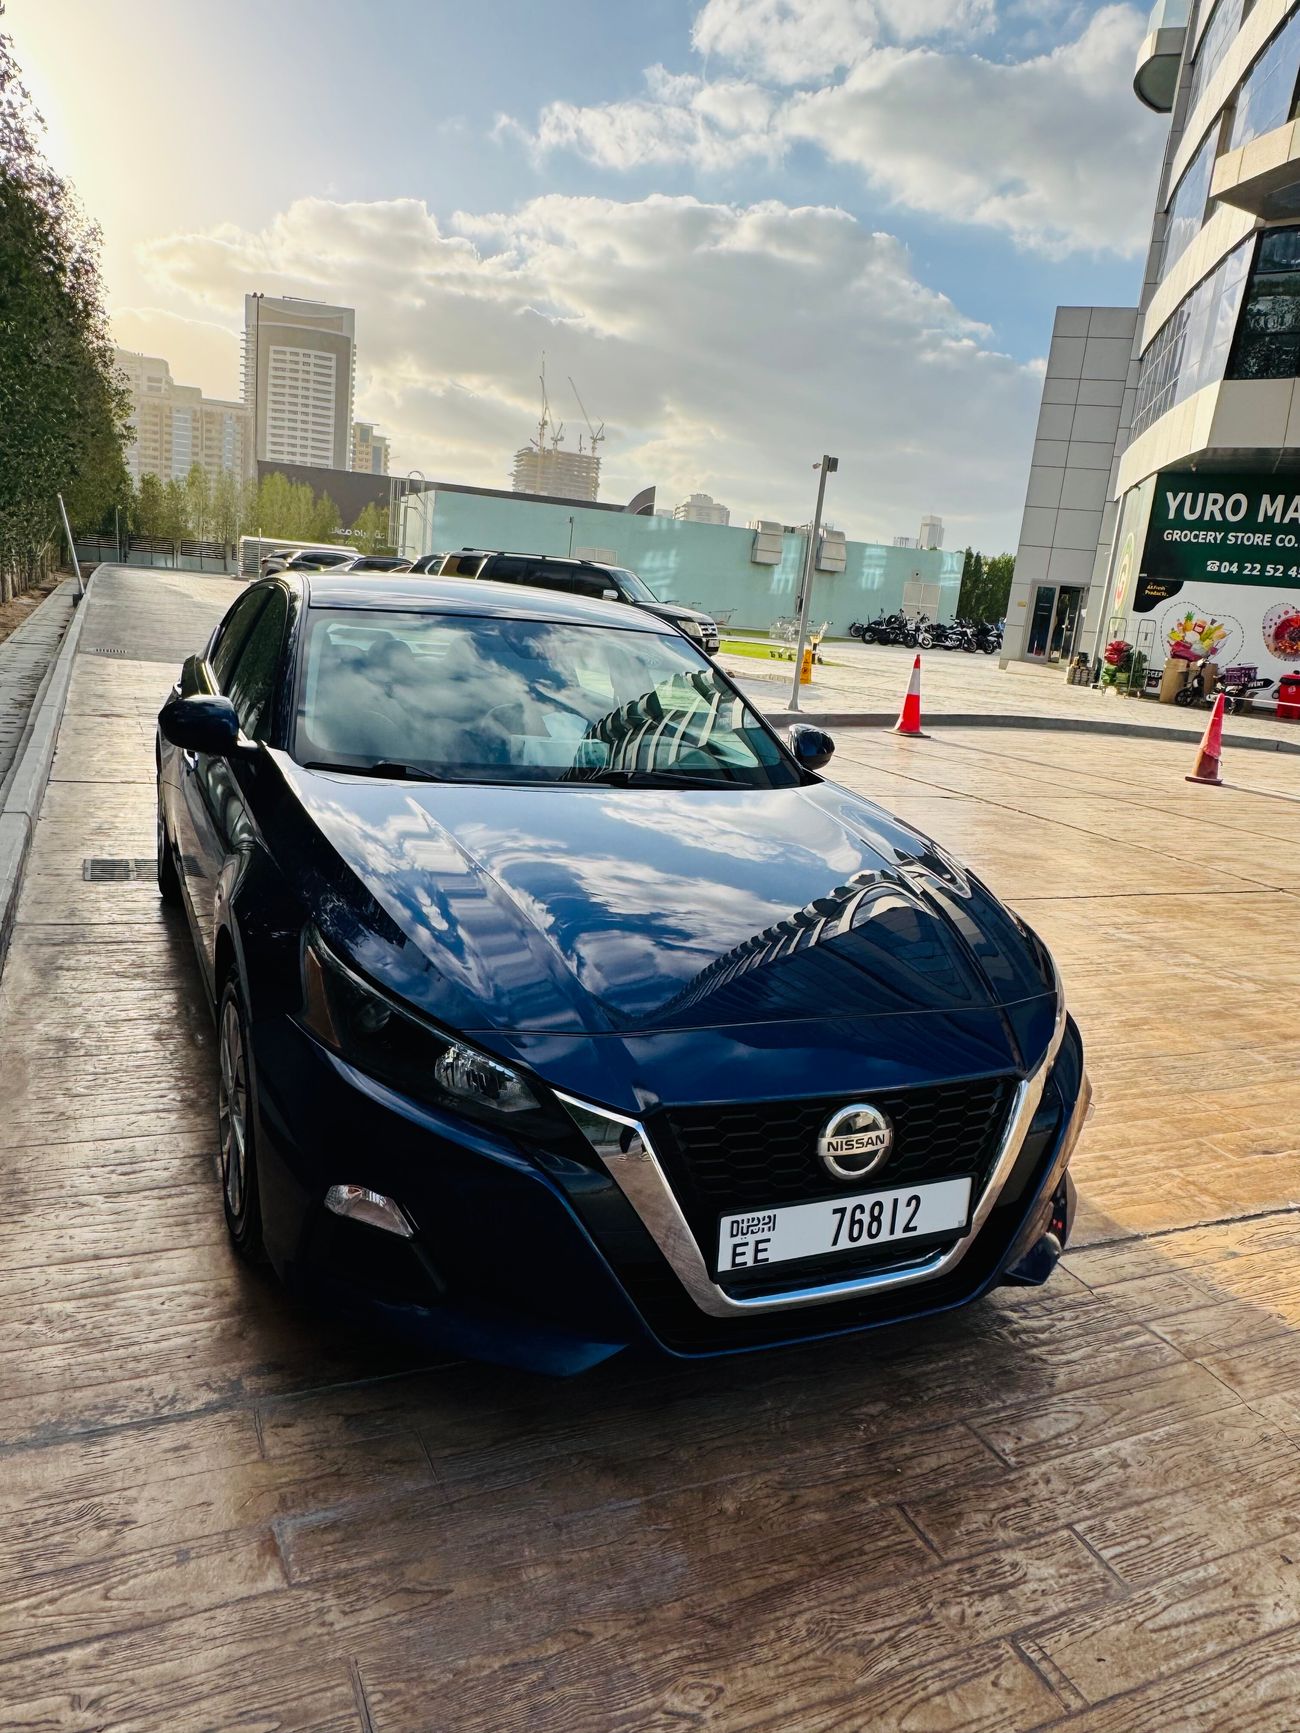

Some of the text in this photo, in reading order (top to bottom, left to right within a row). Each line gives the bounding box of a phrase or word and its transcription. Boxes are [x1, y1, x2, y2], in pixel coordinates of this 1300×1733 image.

[1166, 491, 1300, 524] YURO MA
[1163, 529, 1224, 543] GROCERY
[1226, 532, 1272, 546] STORE
[1220, 561, 1239, 574] 04
[1242, 563, 1261, 575] 22
[1264, 564, 1284, 577] 52
[826, 1133, 886, 1153] NISSAN
[830, 1194, 922, 1247] 76812
[730, 1238, 771, 1269] EE
